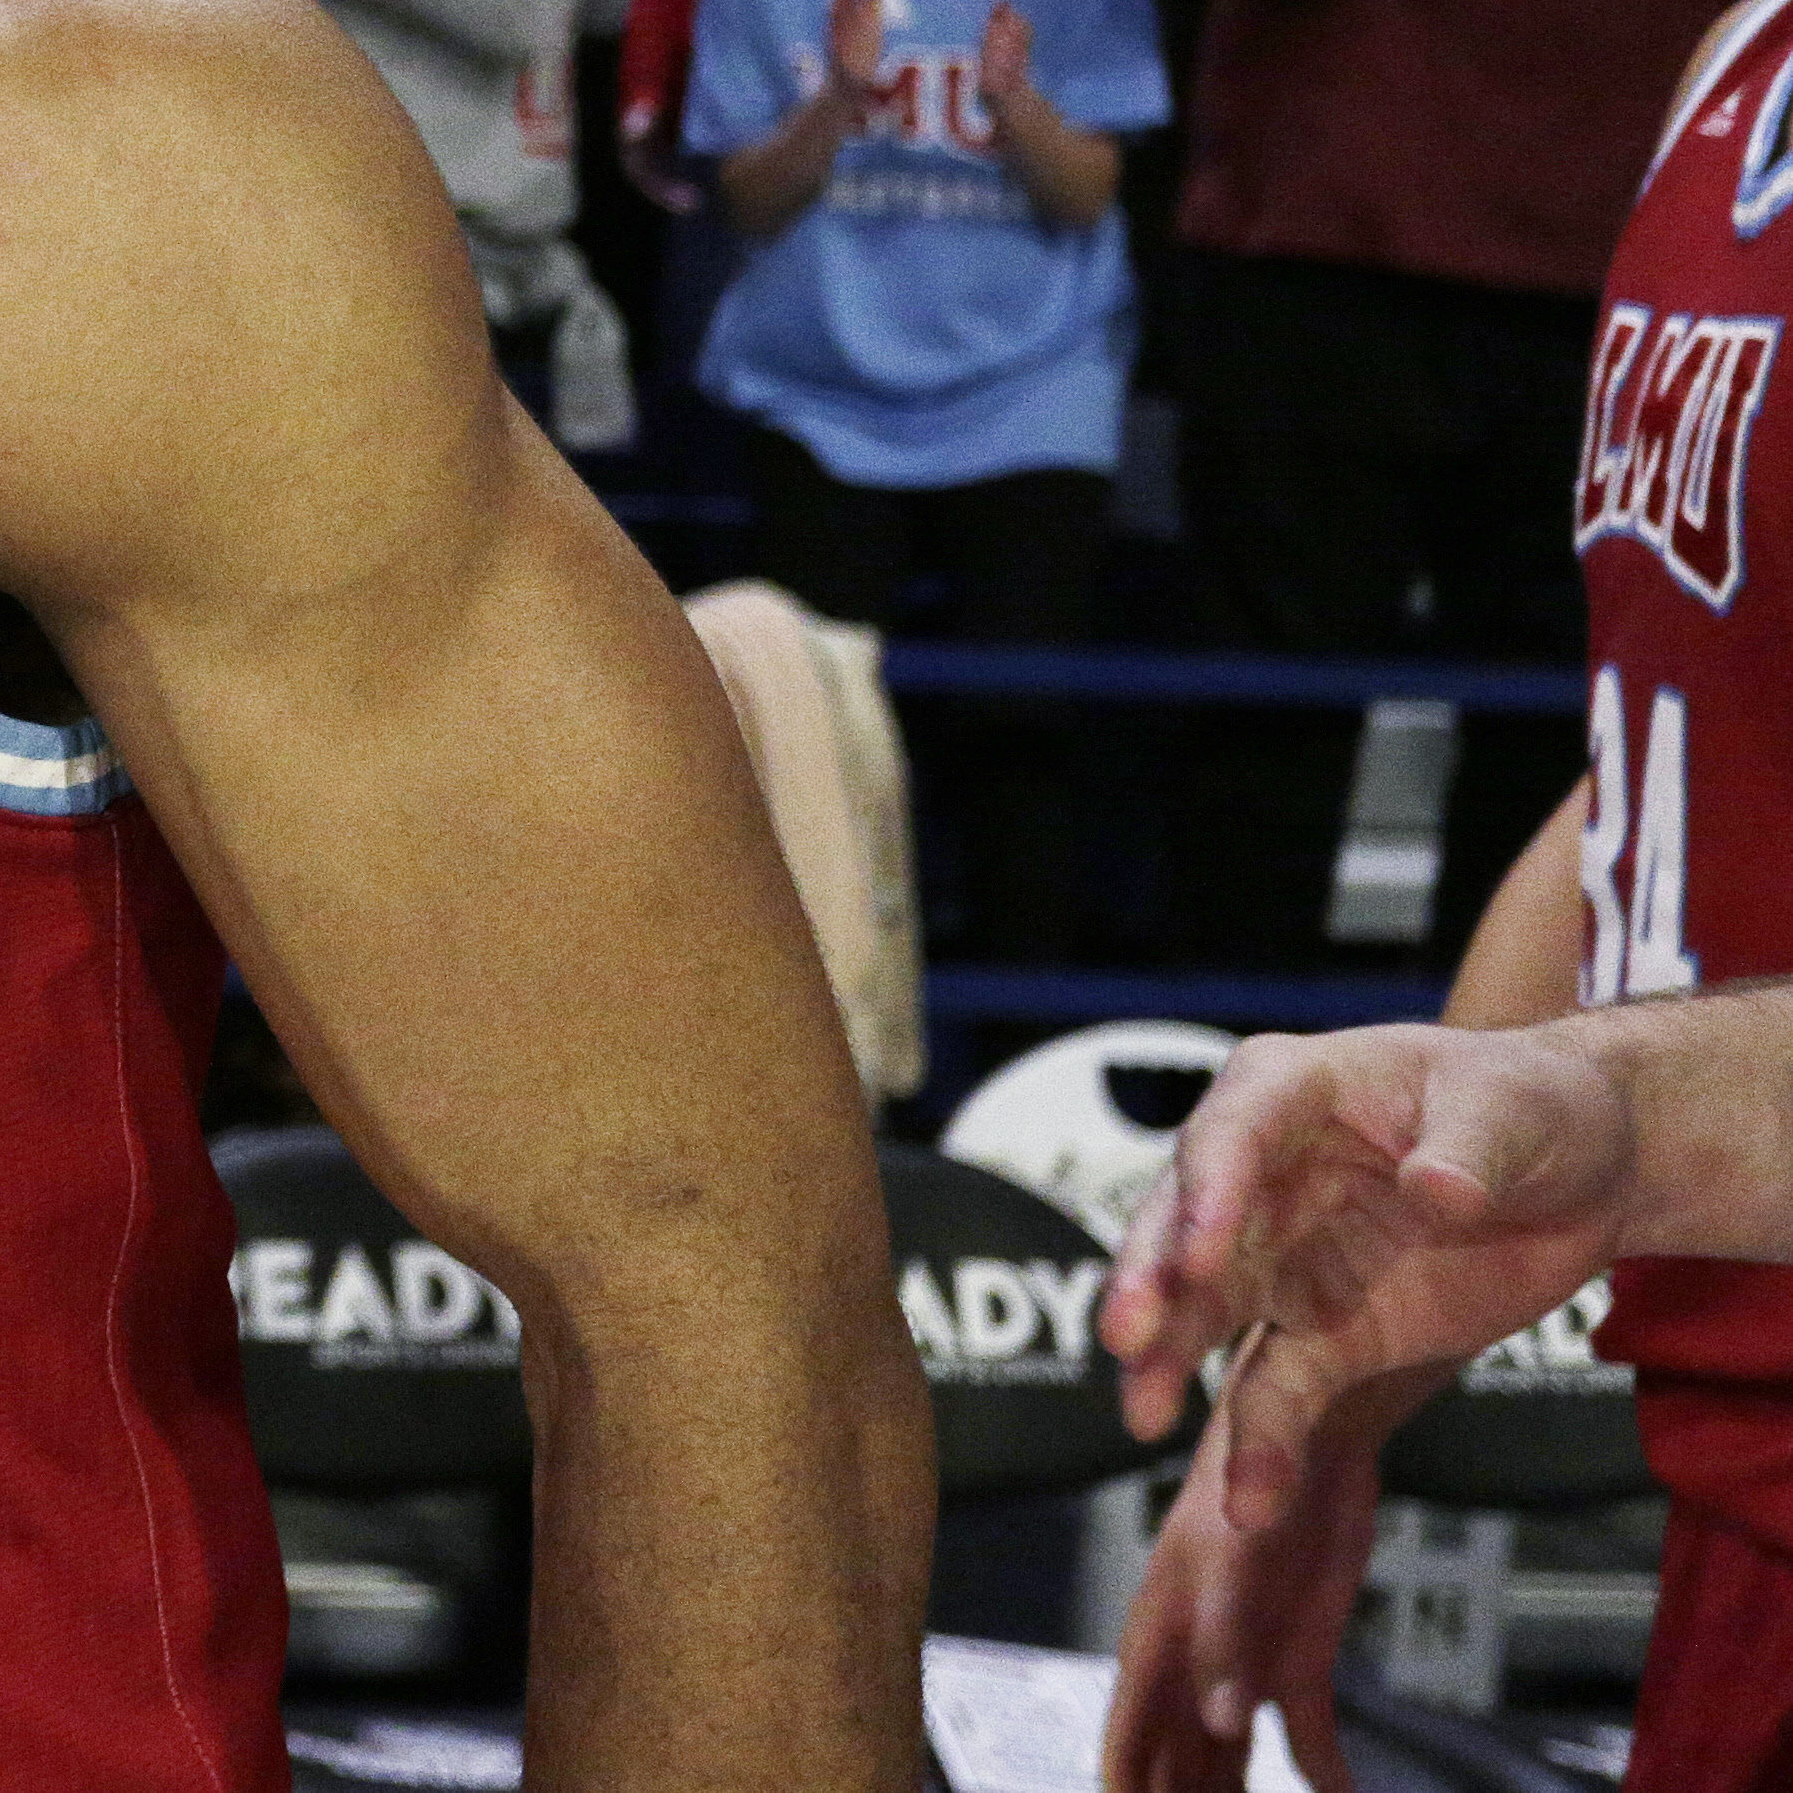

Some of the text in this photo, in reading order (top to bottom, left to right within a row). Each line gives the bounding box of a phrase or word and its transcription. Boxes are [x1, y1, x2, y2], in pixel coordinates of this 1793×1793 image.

[1573, 299, 1785, 619] LMU
[227, 1238, 522, 1342] EAD
[898, 1256, 1108, 1361] ADY
